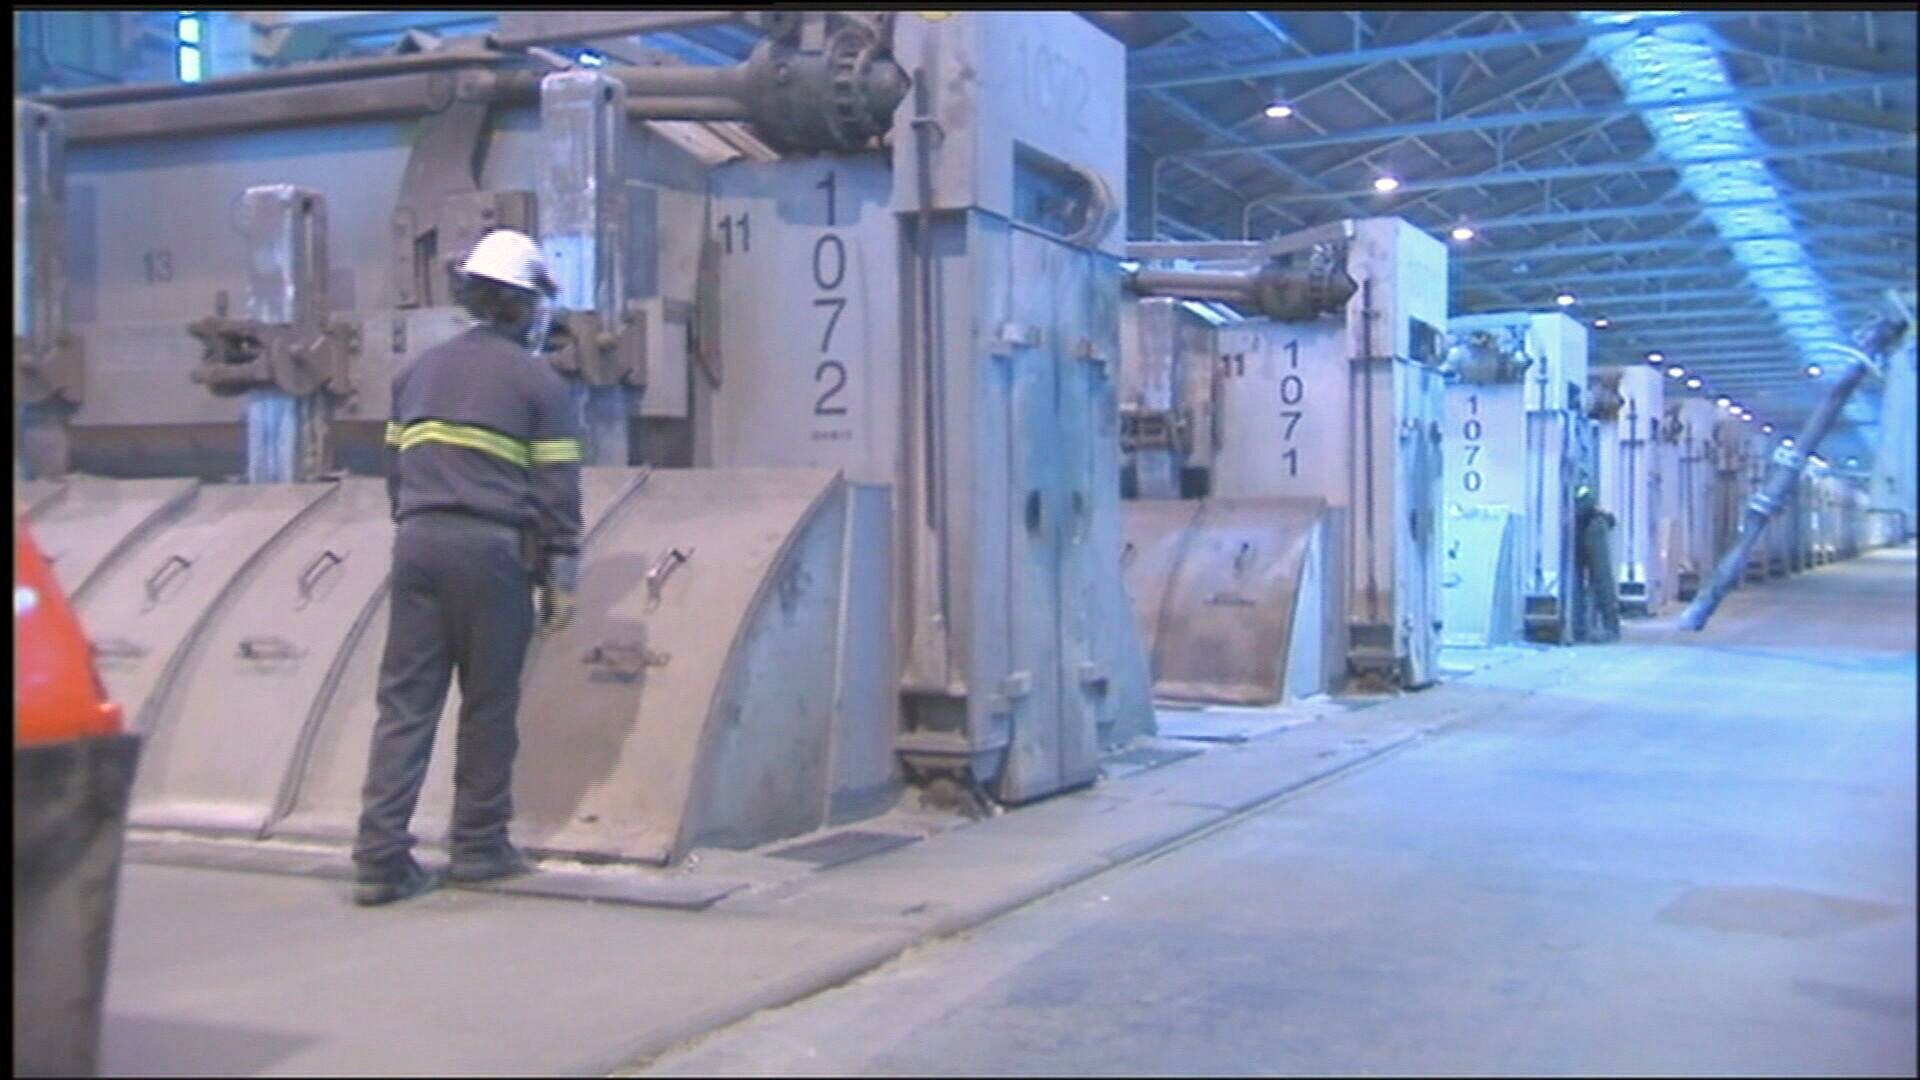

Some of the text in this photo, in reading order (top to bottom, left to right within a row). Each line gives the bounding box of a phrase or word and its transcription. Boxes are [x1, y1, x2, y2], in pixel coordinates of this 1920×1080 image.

[142, 251, 174, 285] 13
[718, 213, 750, 254] 11
[812, 170, 848, 416] 1072
[1221, 353, 1244, 378] 11
[1280, 339, 1304, 477] 1071
[1463, 394, 1482, 492] 1070
